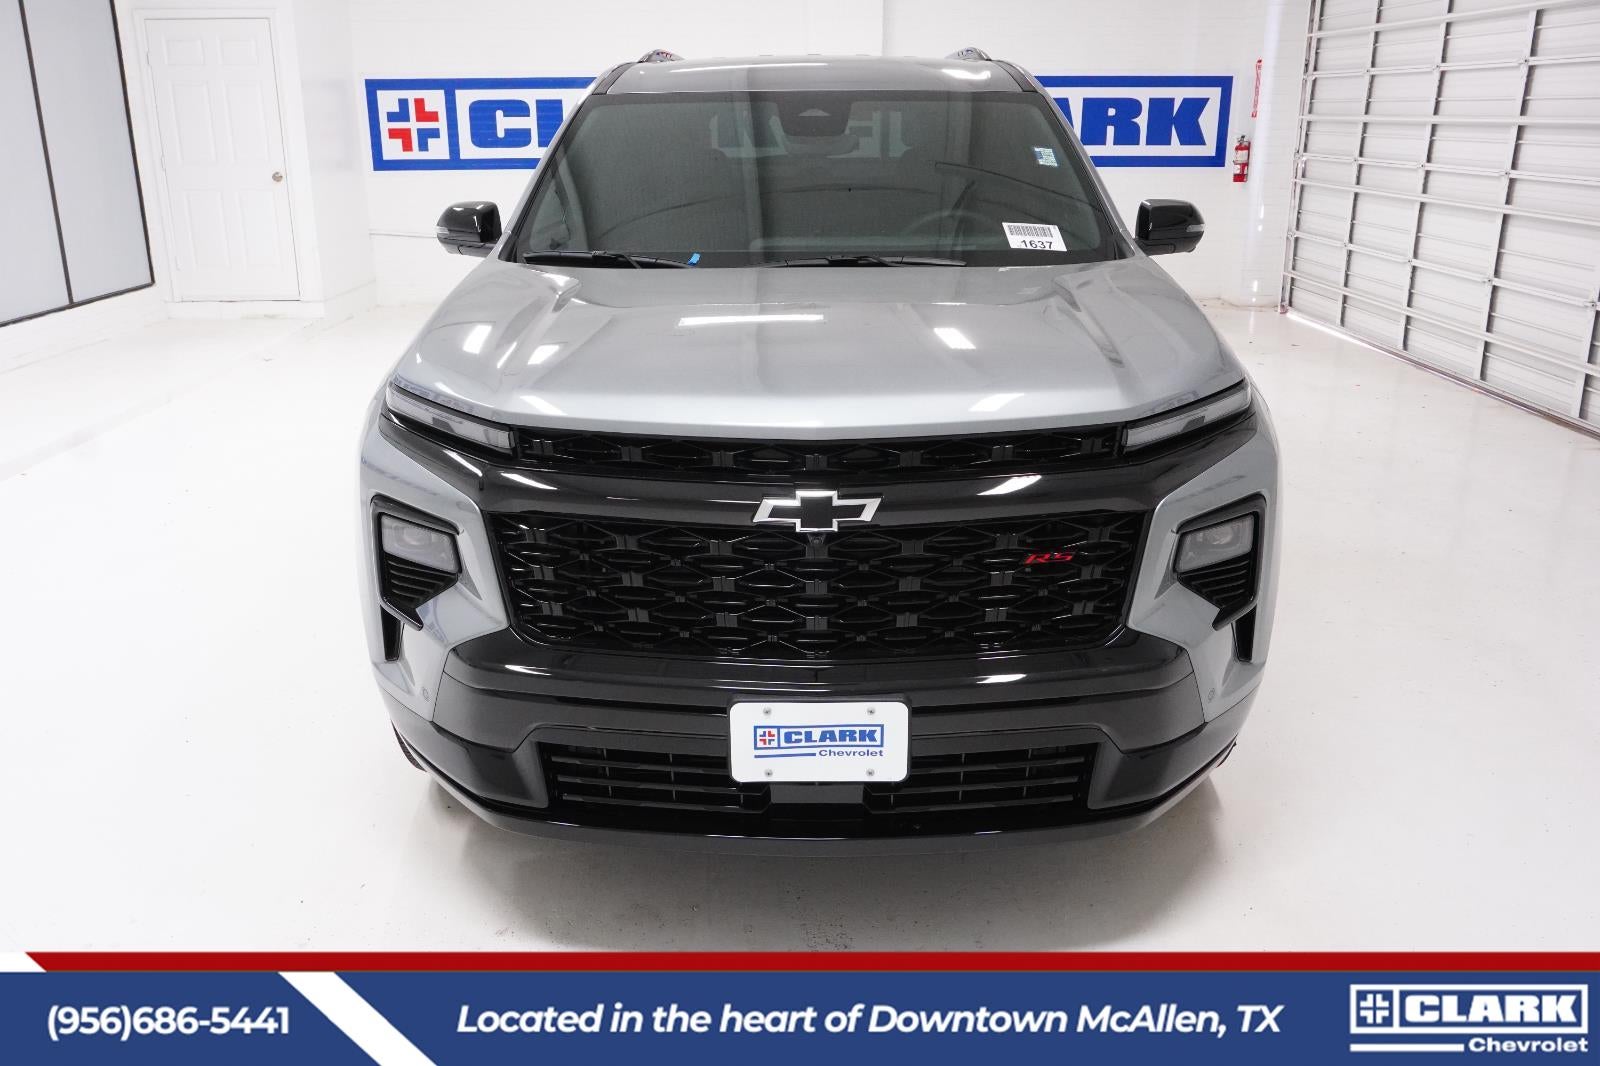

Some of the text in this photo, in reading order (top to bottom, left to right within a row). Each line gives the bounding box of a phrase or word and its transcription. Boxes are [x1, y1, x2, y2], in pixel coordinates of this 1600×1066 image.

[1020, 239, 1053, 250] 1637
[1024, 552, 1073, 565] RS
[783, 729, 878, 744] CLARK
[818, 749, 884, 757] Chevrolet
